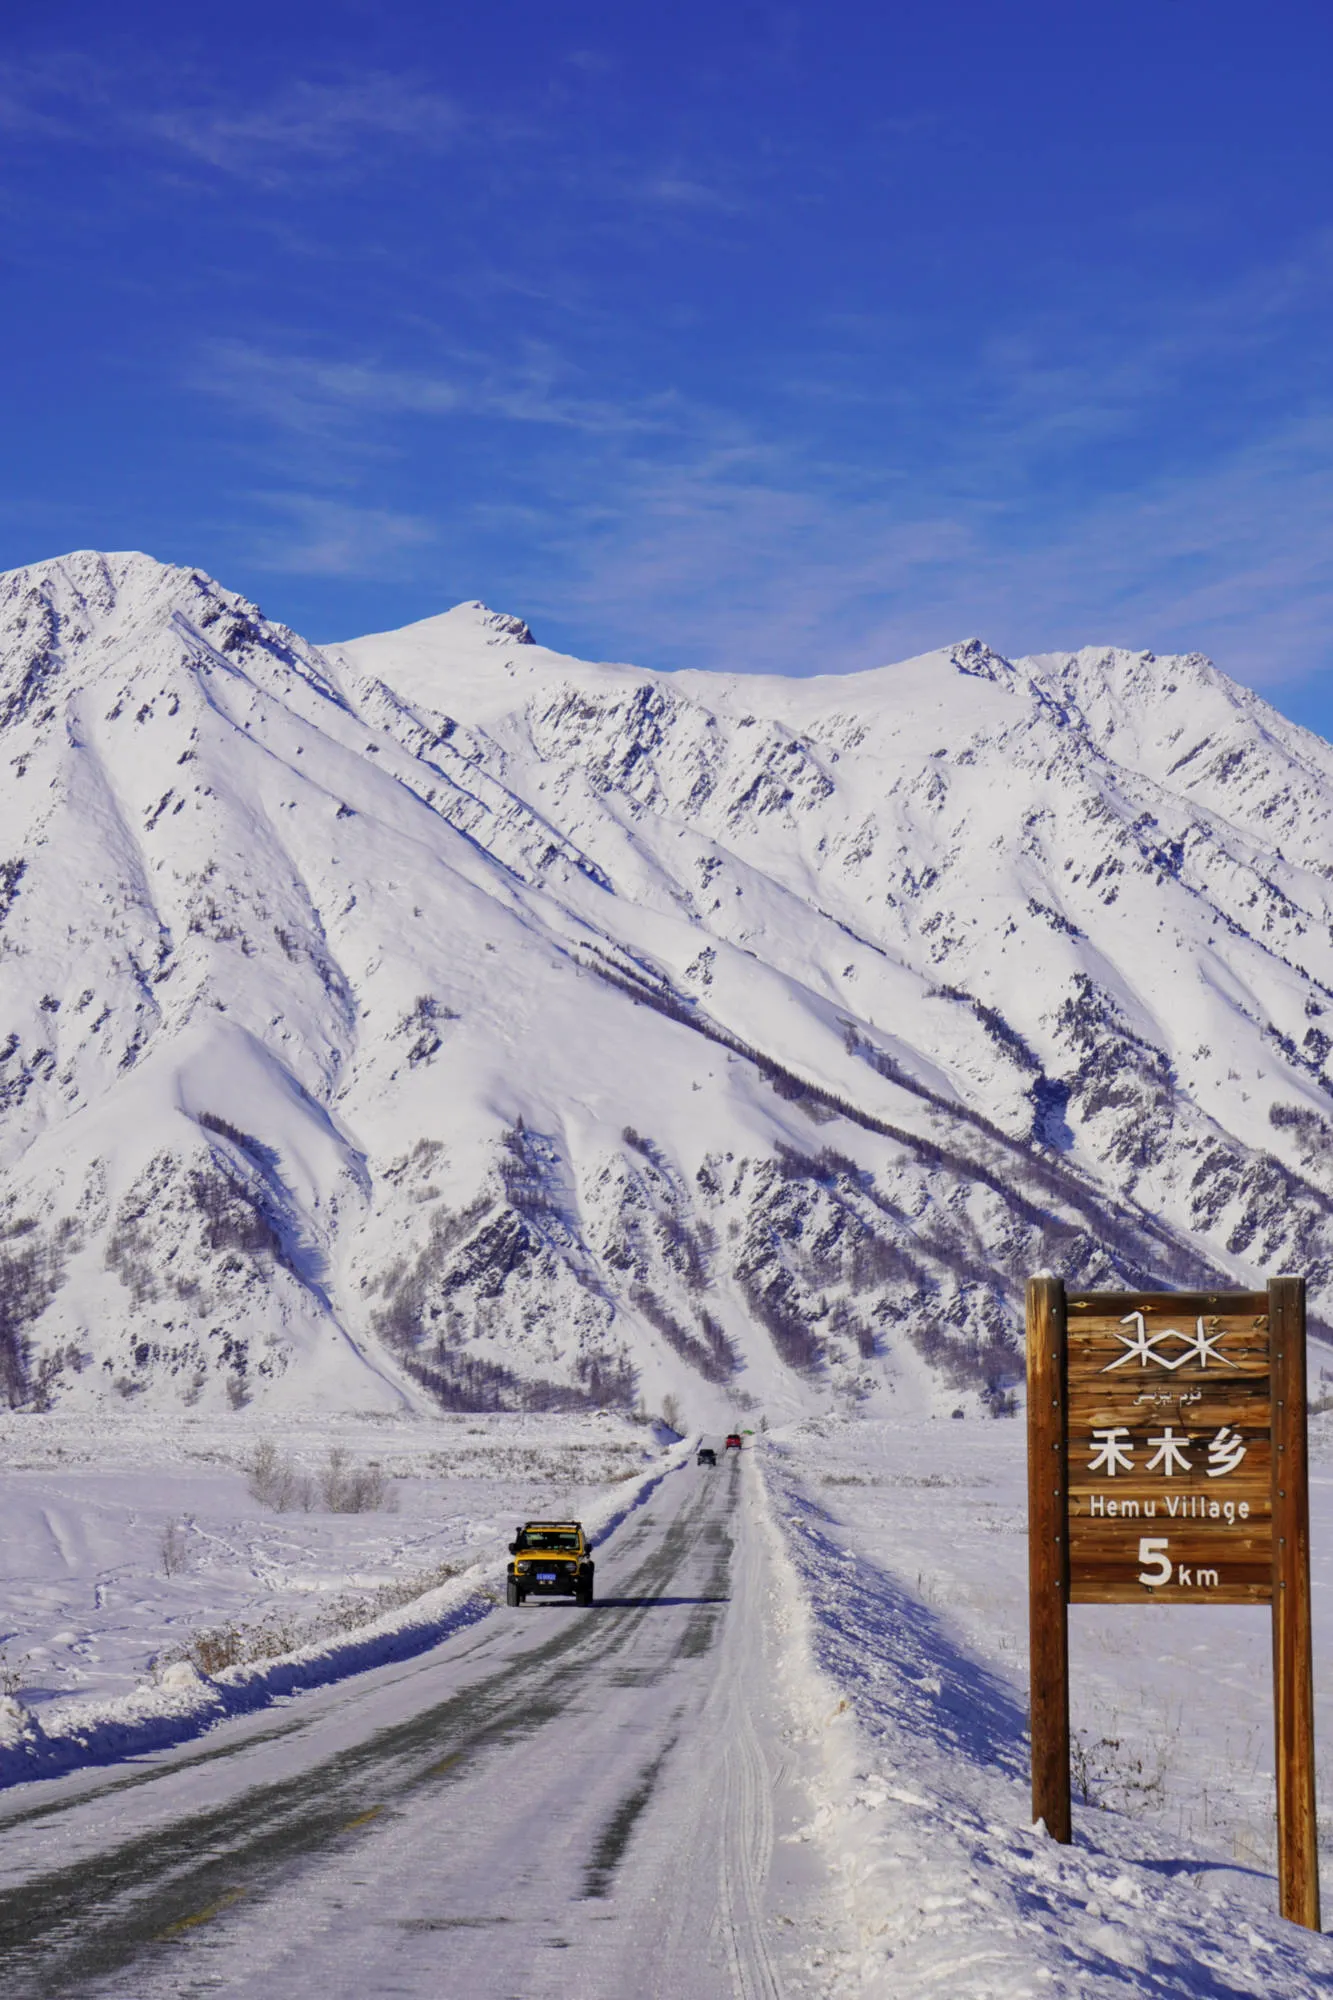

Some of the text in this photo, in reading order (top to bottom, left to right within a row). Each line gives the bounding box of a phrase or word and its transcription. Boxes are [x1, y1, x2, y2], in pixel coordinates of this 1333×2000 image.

[1087, 1427, 1247, 1477] 禾木乡
[1090, 1495, 1250, 1525] Hemu Village
[1138, 1537, 1219, 1586] 5 km
